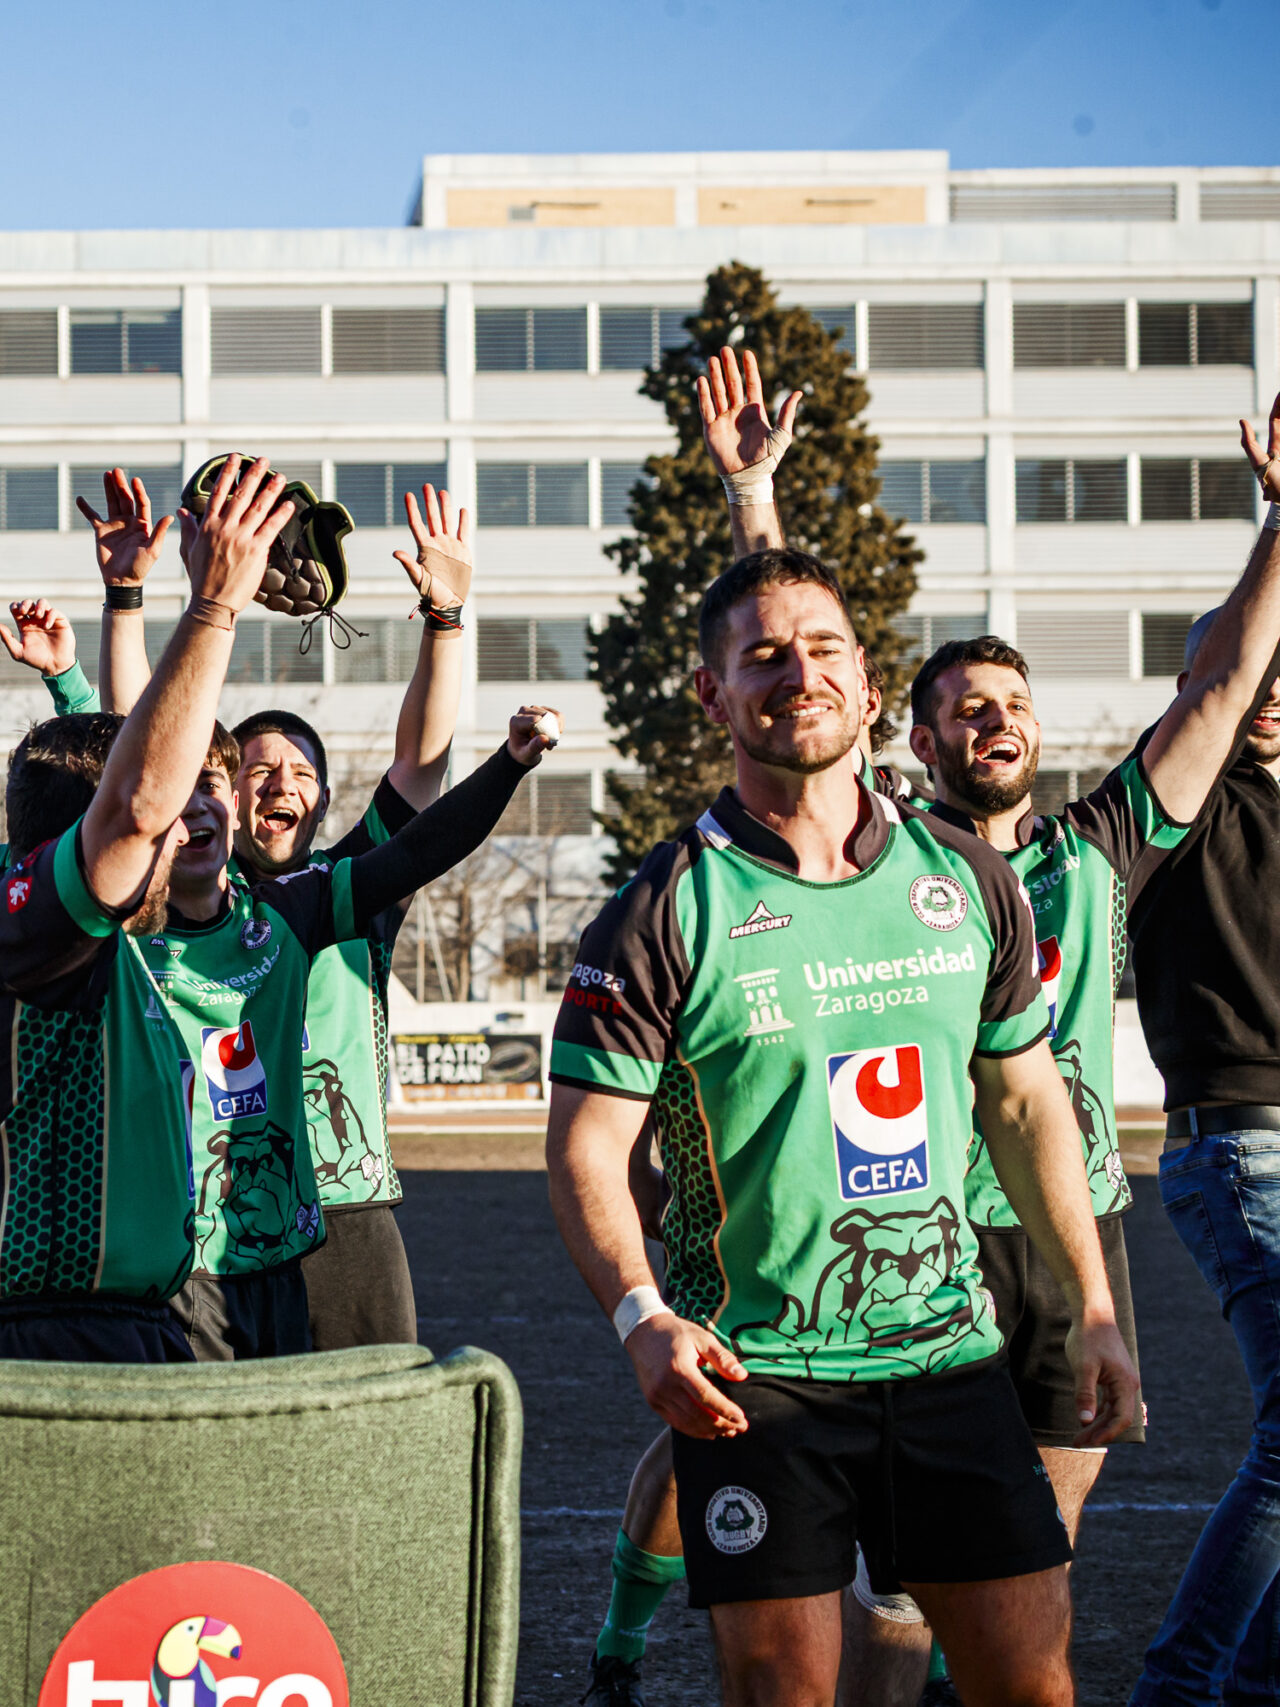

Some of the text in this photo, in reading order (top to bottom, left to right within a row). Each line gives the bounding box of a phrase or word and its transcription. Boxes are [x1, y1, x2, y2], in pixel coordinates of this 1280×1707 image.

[729, 914, 792, 939] MERCURY
[802, 943, 977, 991] Universidad
[811, 985, 929, 1018] Zaragoza
[756, 1034, 785, 1047] 1542
[426, 1042, 491, 1065] PATIO
[427, 1063, 483, 1084] FRAN
[217, 1091, 265, 1117] CEFA
[847, 1158, 924, 1194] CEFA
